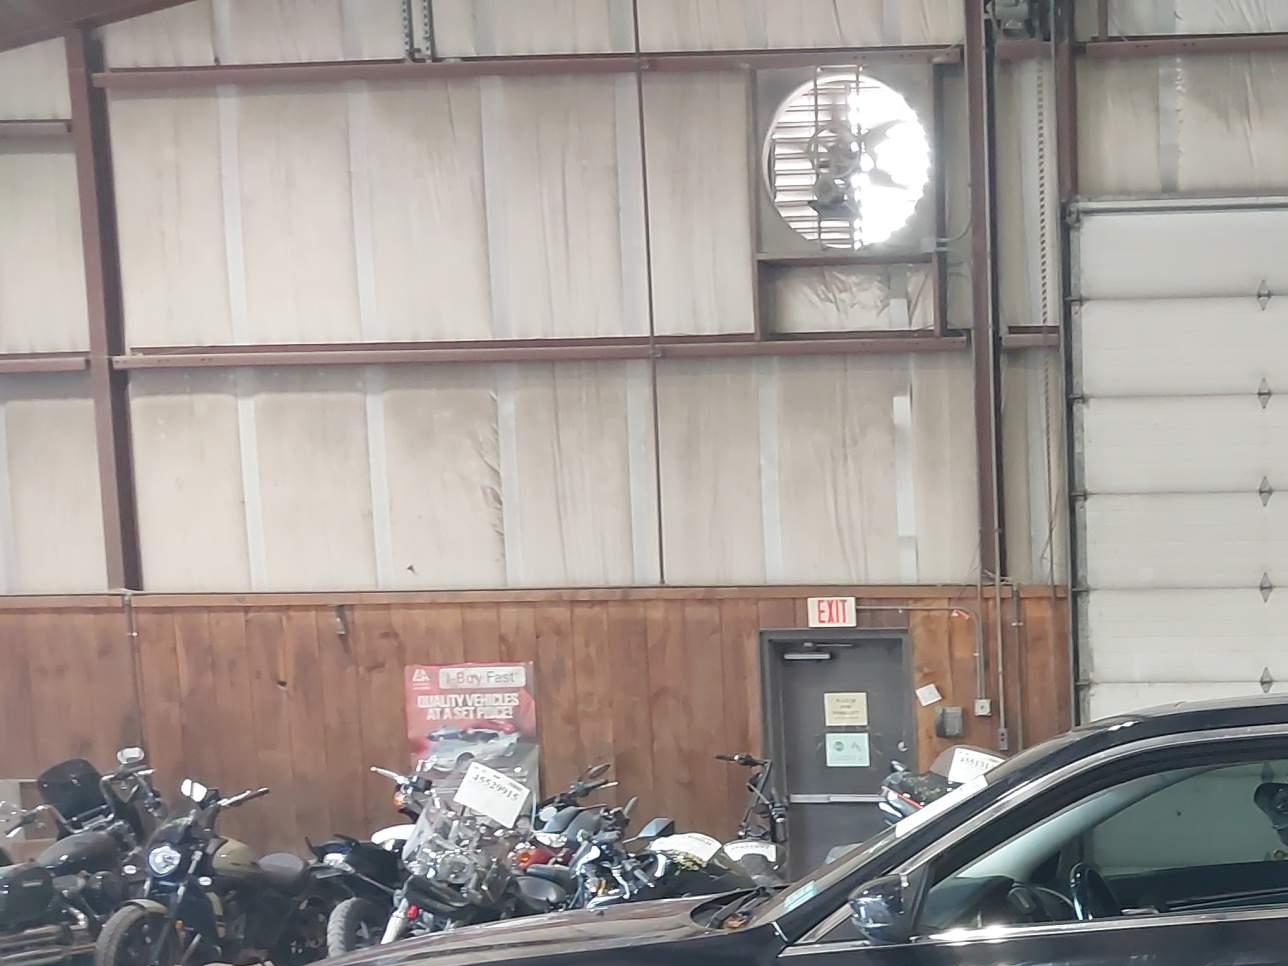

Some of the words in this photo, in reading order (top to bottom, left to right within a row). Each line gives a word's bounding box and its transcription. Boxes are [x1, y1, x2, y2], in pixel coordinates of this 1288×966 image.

[817, 599, 848, 624] EXIT
[486, 670, 516, 684] Fast
[417, 695, 464, 709] QUALITY
[465, 694, 519, 707] VEHICLES
[426, 708, 443, 721] AT
[453, 706, 475, 720] SET
